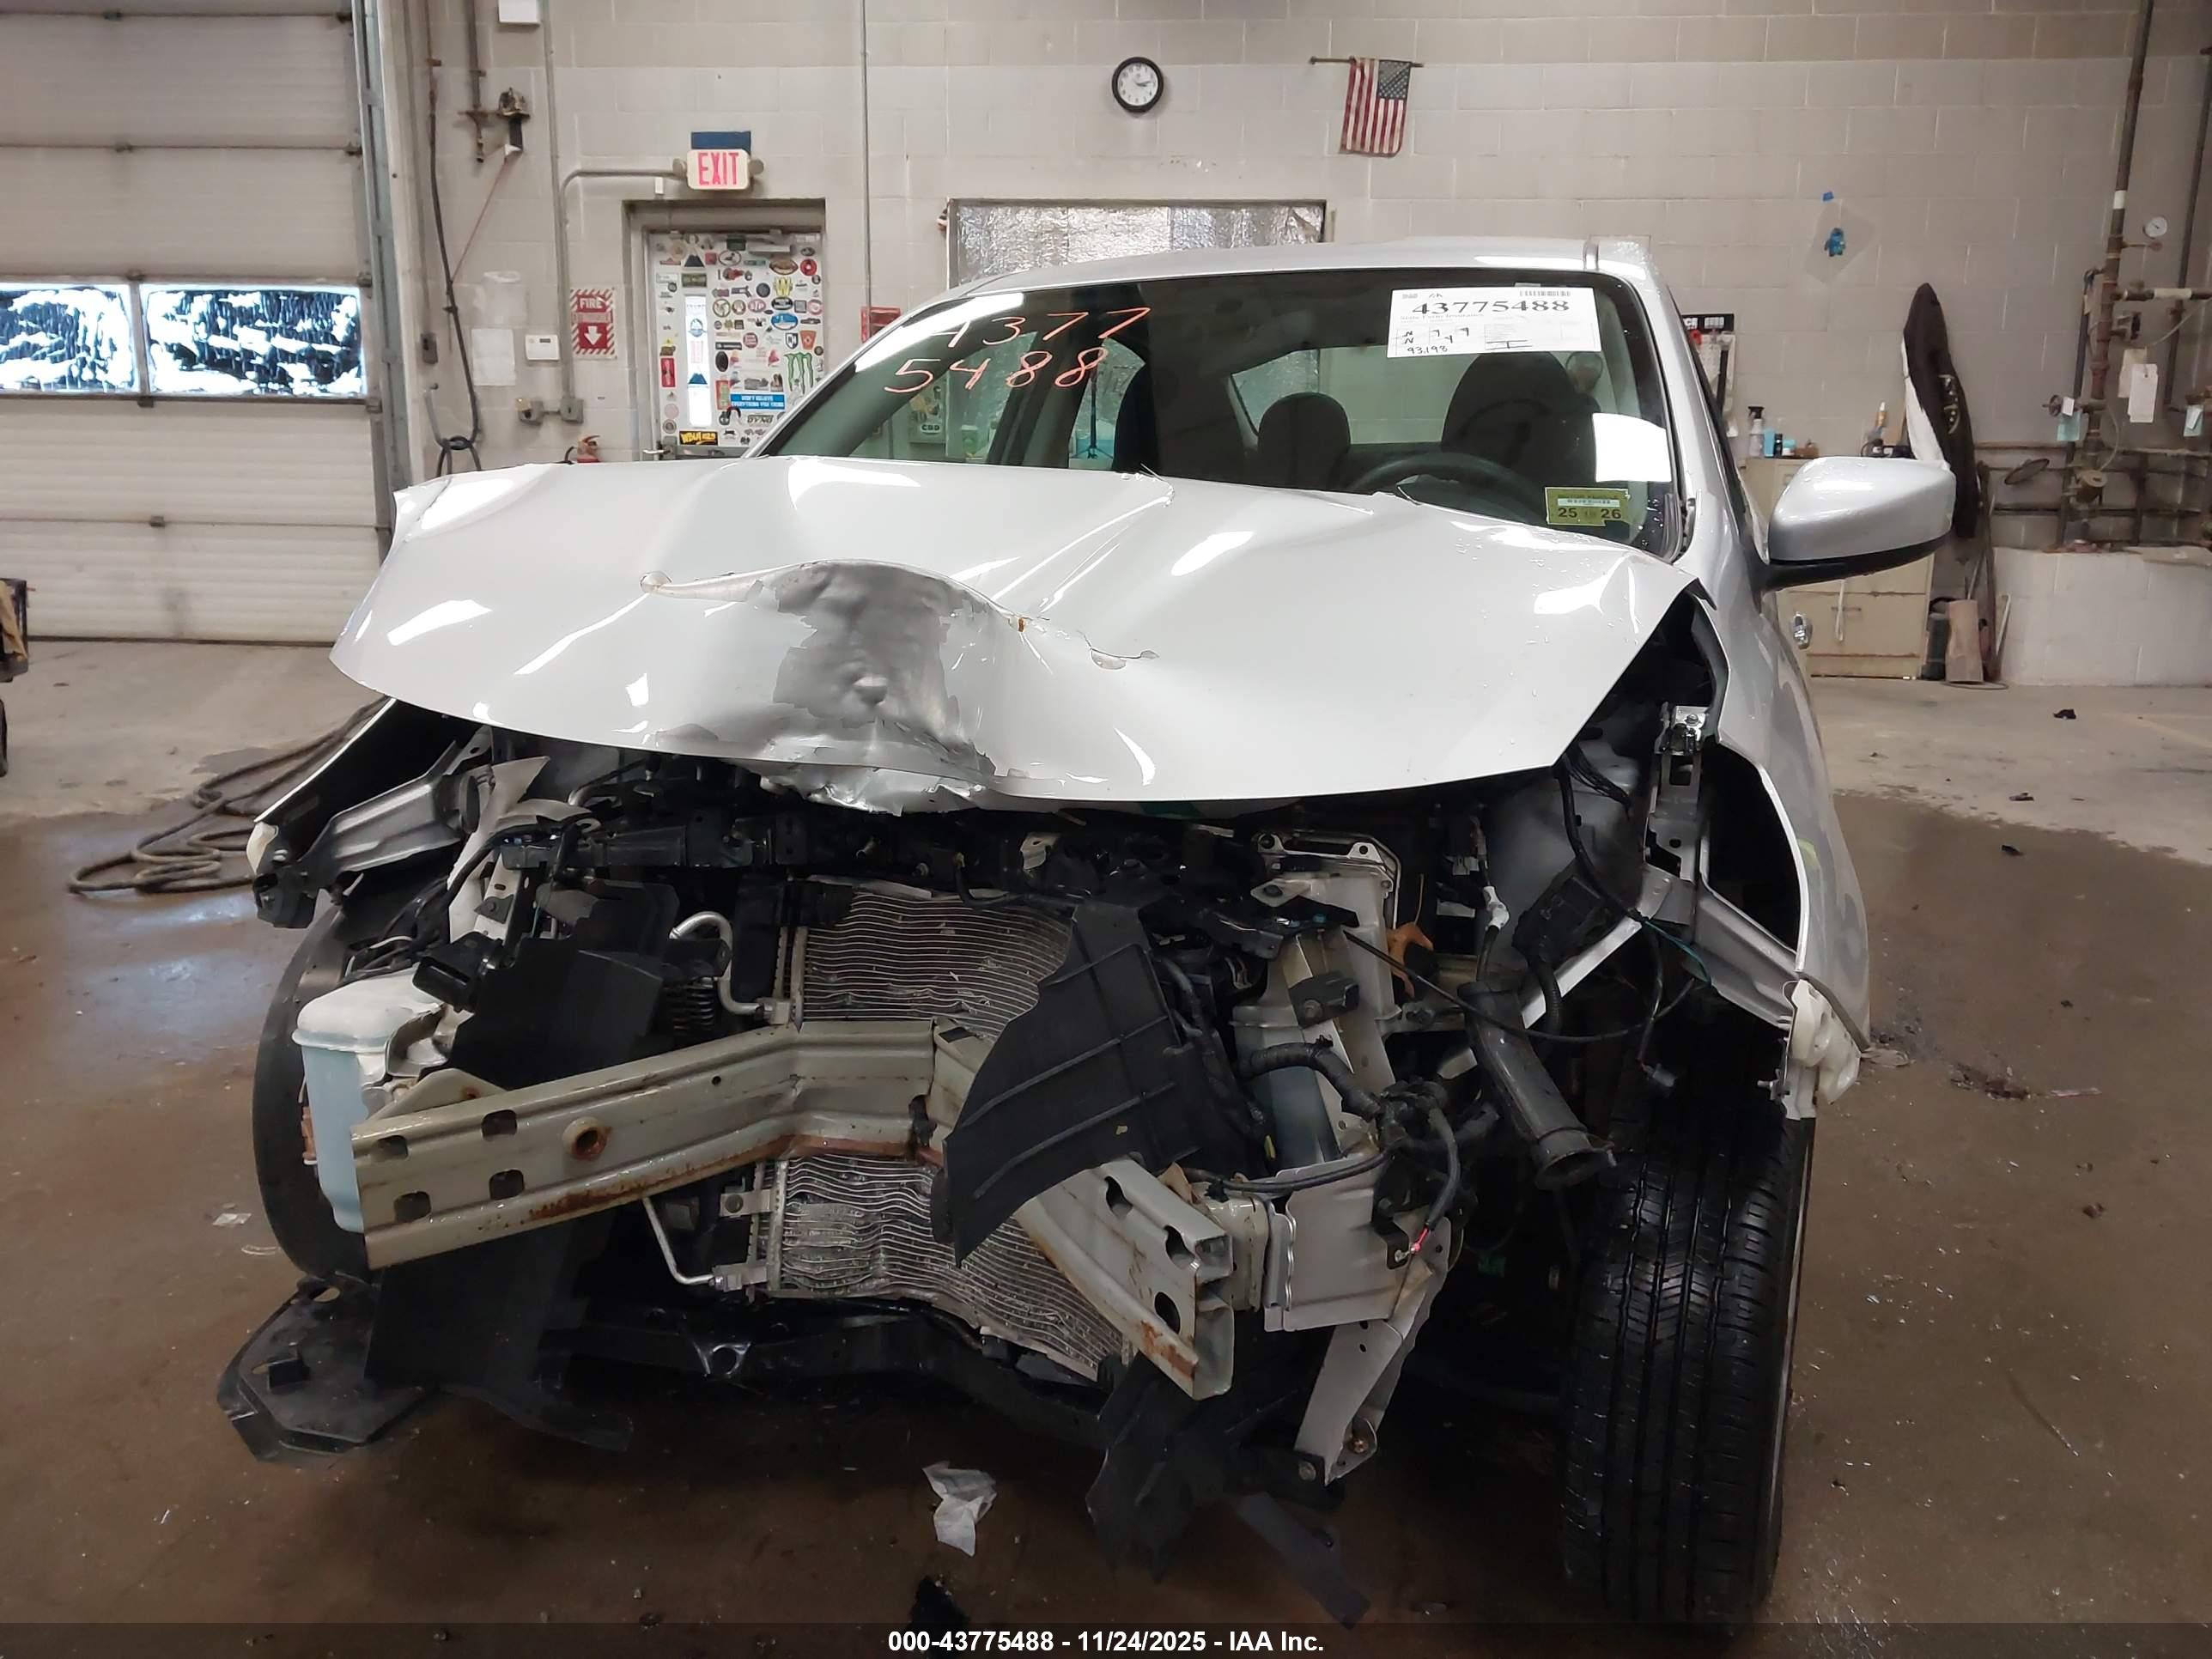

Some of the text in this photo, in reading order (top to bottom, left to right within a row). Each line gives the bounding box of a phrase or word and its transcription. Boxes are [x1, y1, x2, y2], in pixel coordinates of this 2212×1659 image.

[697, 152, 739, 185] EXIT
[579, 296, 604, 309] FIRE
[1412, 300, 1570, 314] 43775488
[884, 347, 1109, 392] 5488
[1558, 507, 1577, 518] 25
[1601, 508, 1622, 519] 26
